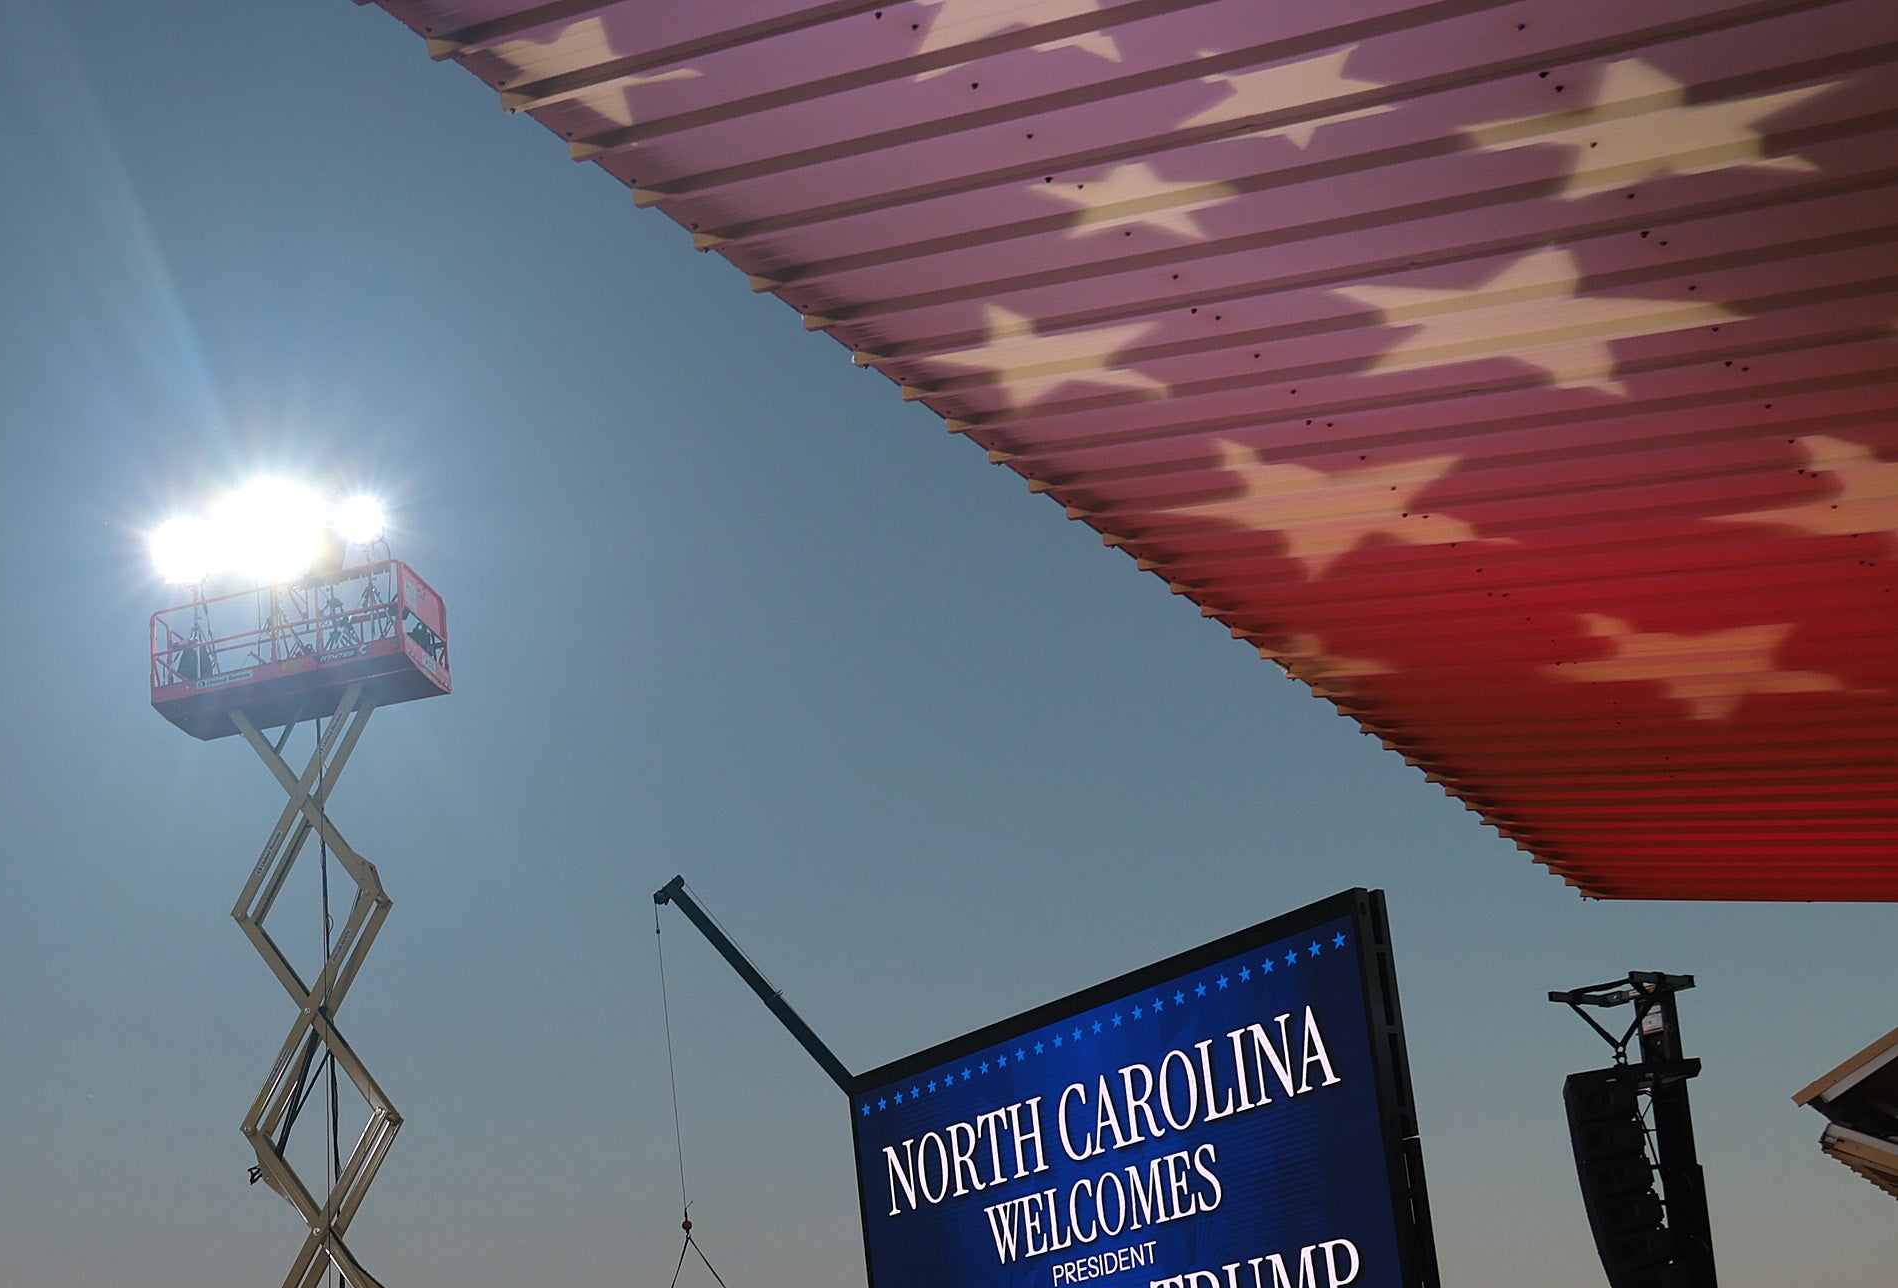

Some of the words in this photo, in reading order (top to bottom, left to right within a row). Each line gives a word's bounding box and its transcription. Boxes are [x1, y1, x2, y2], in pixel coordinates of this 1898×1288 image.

[883, 1097, 1049, 1216] NORTH
[1059, 1006, 1341, 1160] CAROLINA
[984, 1144, 1222, 1264] WELCOMES
[1053, 1241, 1157, 1287] PRESIDENT
